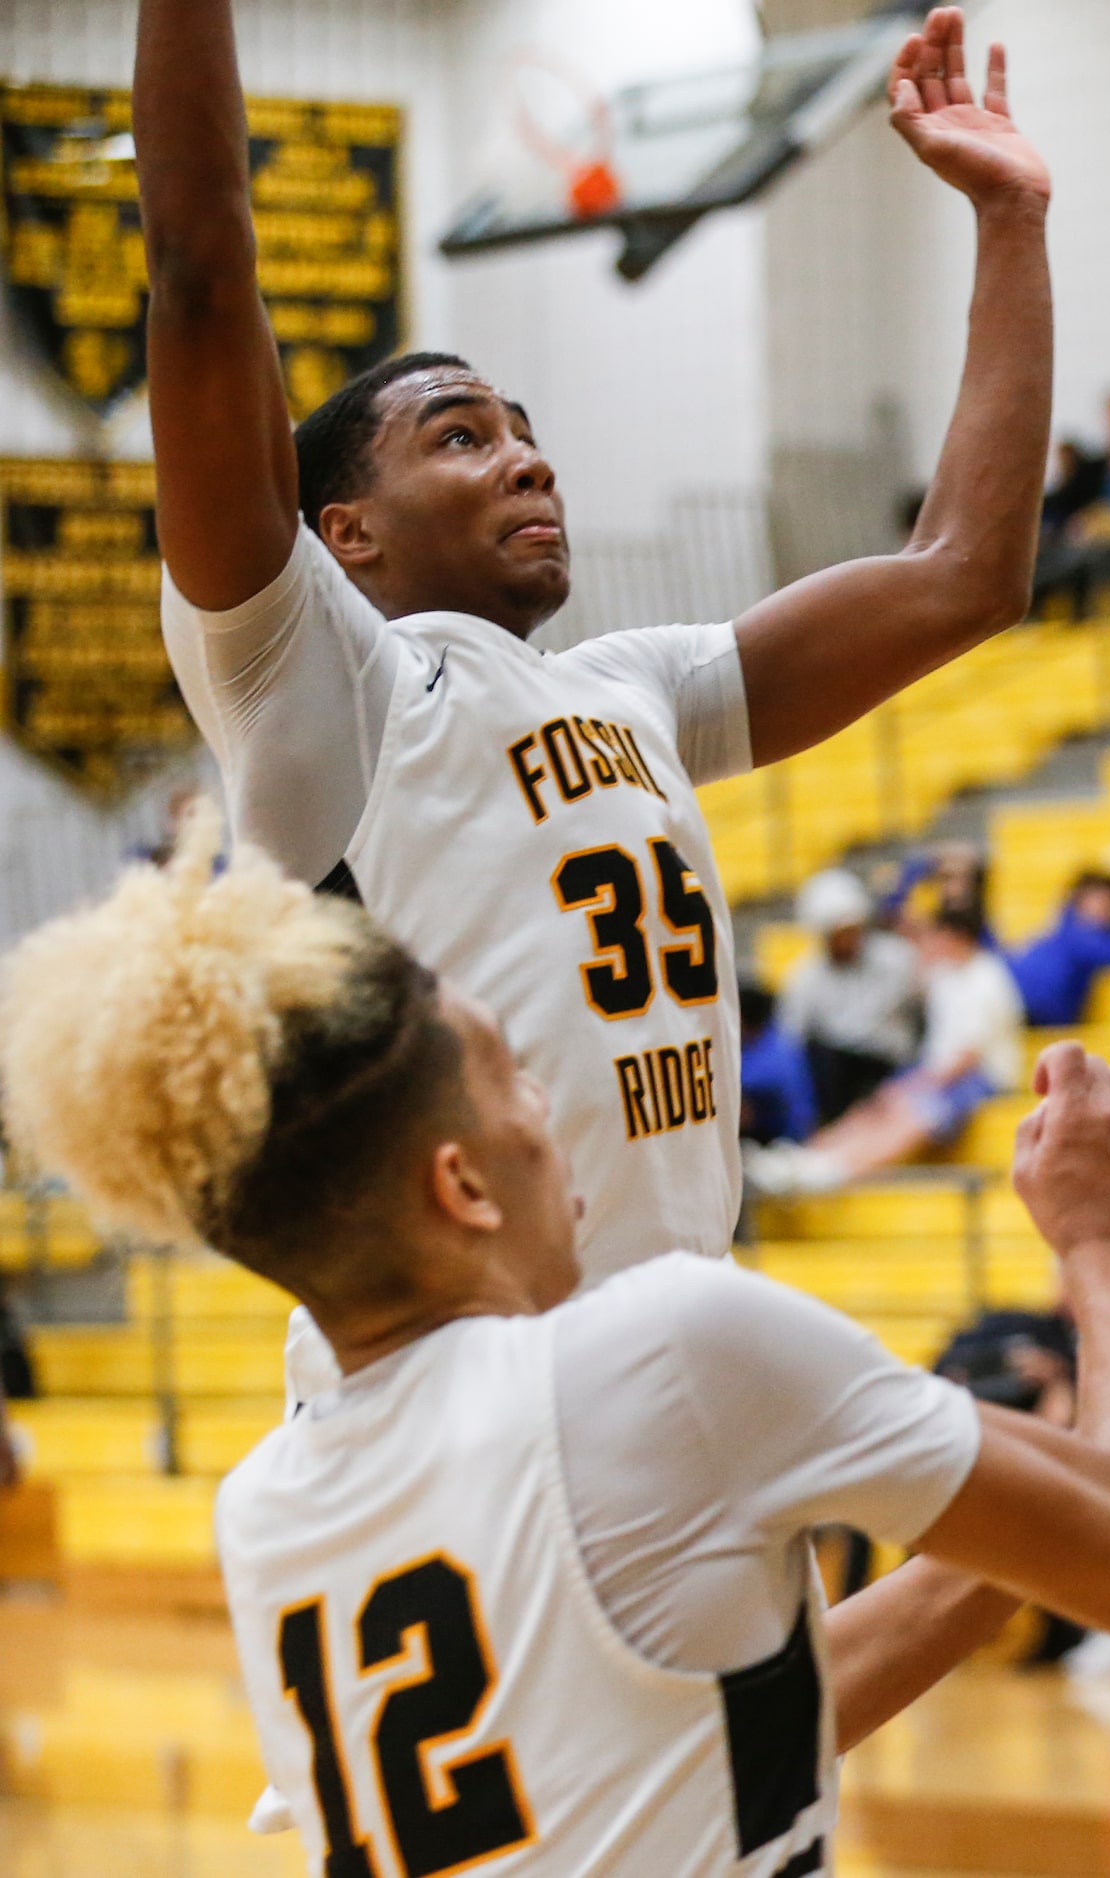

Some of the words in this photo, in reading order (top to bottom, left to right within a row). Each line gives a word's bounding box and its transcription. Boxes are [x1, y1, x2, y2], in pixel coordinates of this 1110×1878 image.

[550, 835, 719, 1022] 35
[613, 1035, 717, 1142] RIDGE
[277, 1547, 539, 1878] 12
